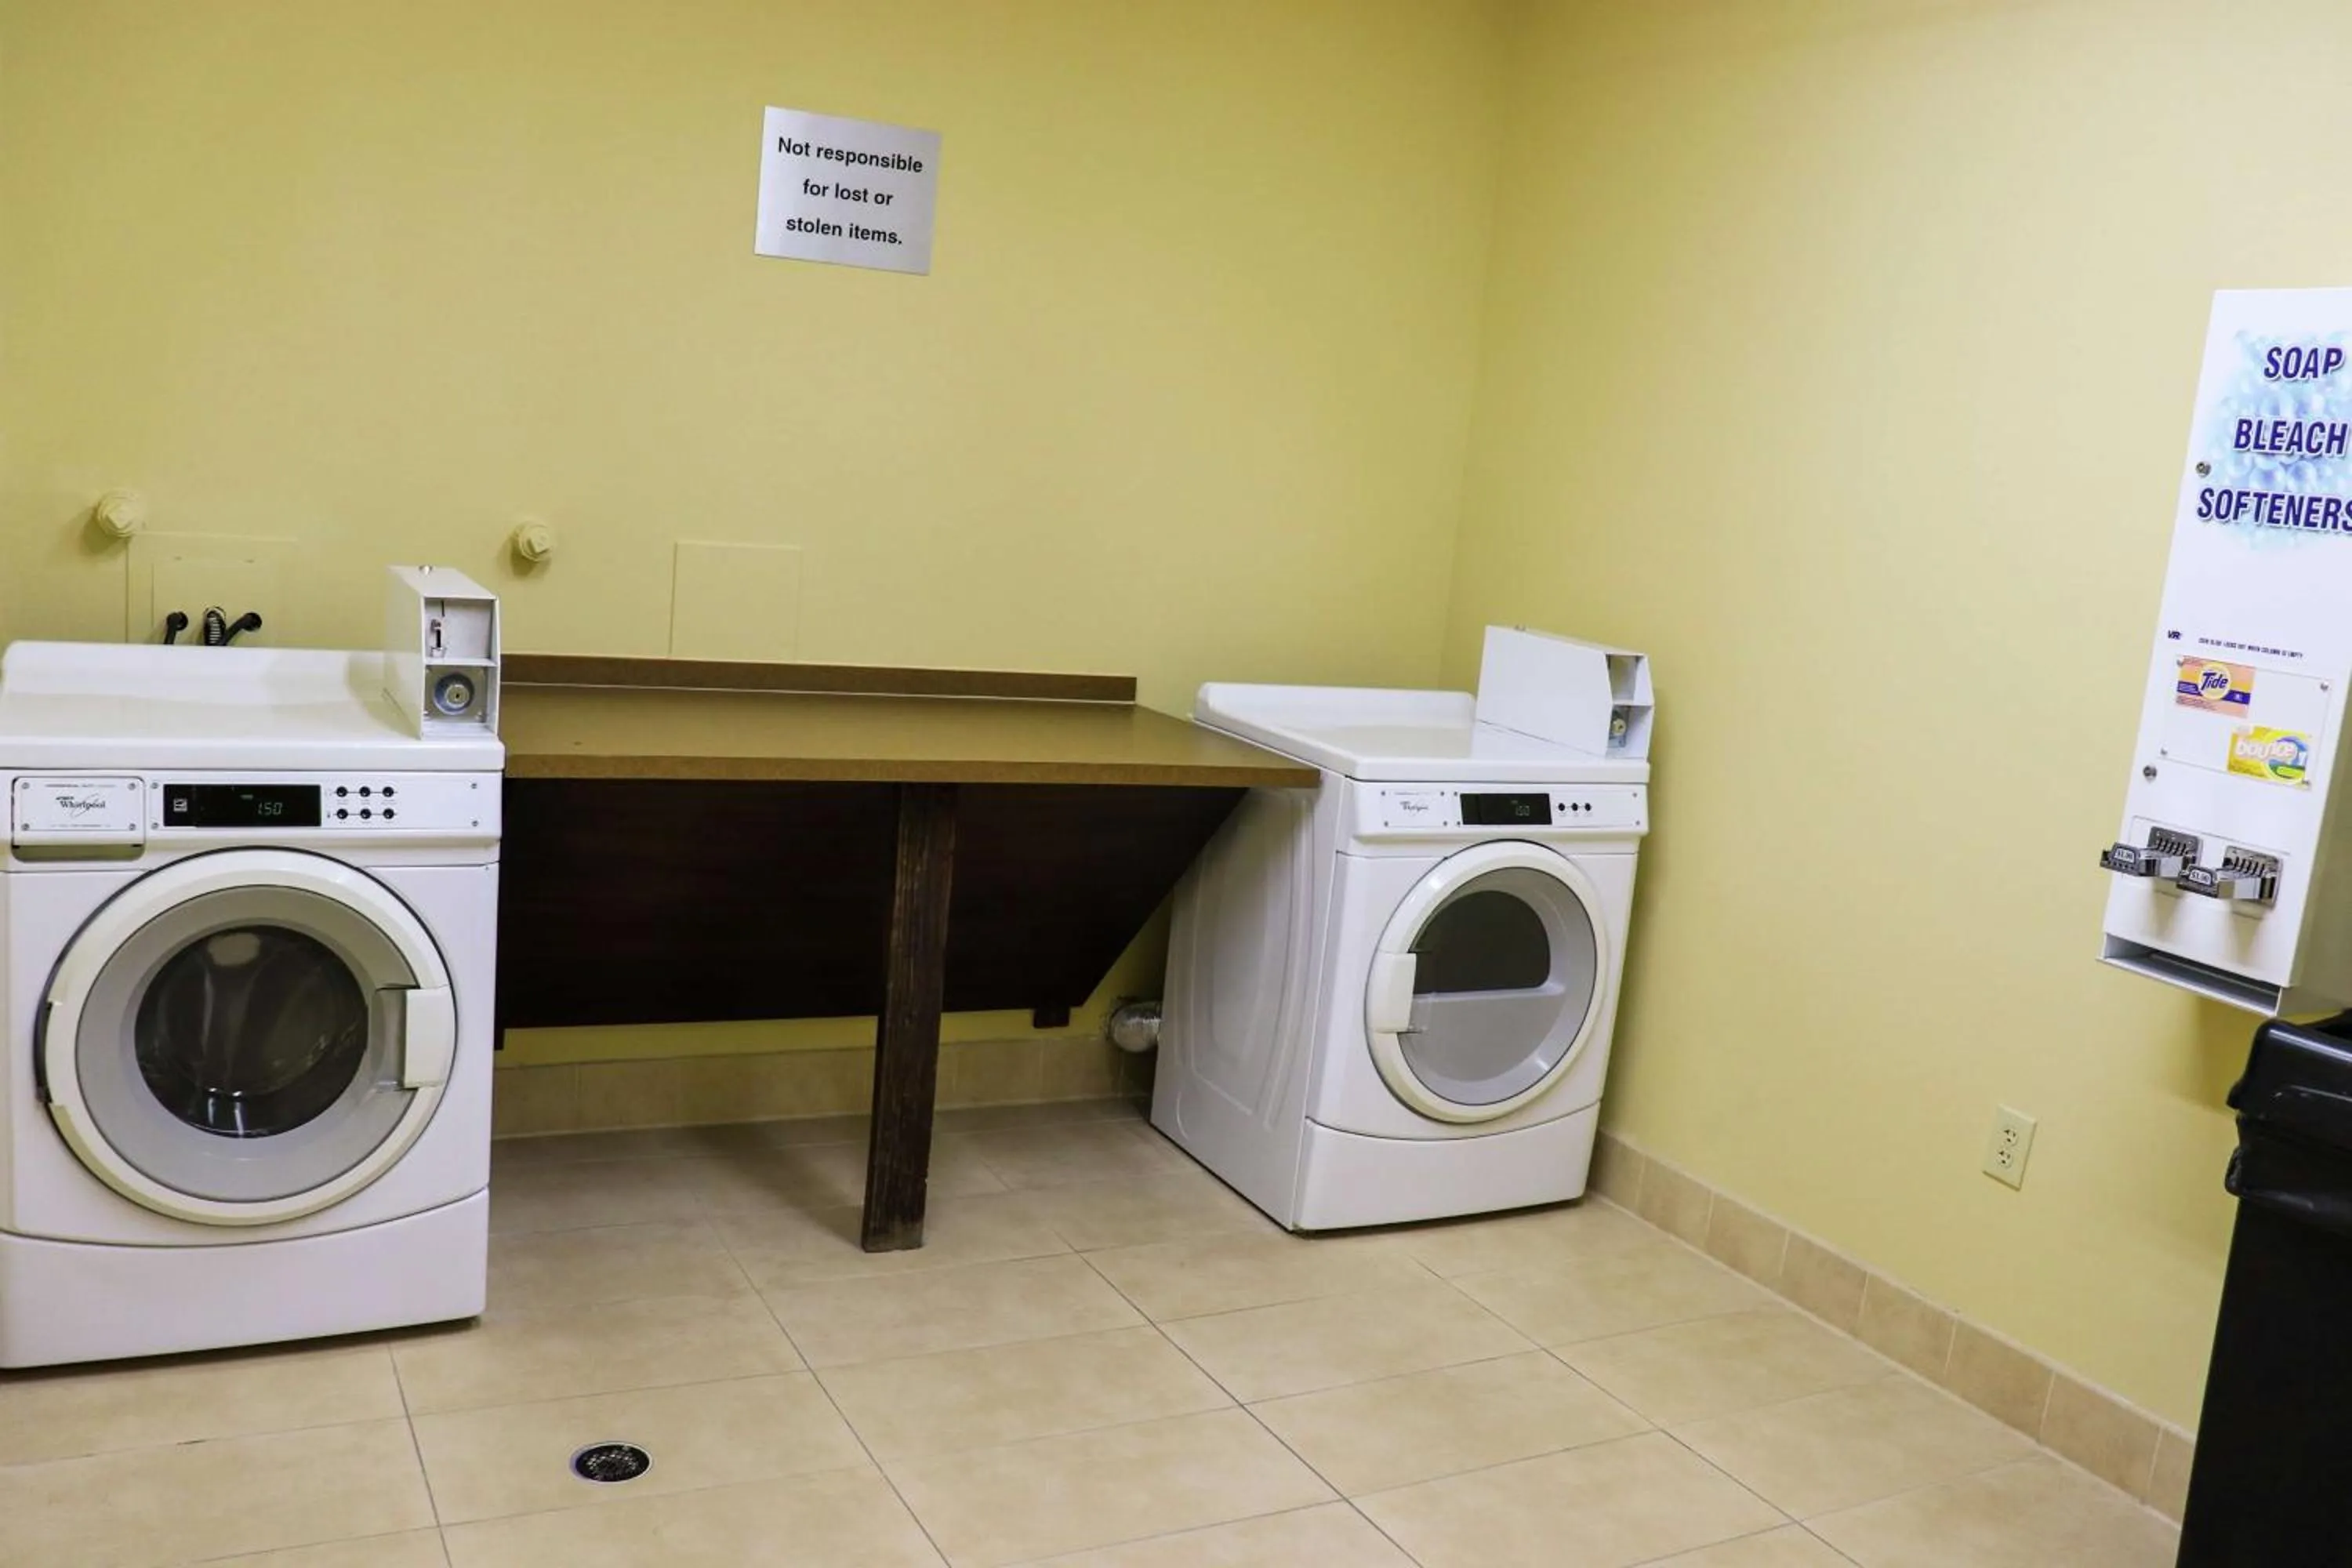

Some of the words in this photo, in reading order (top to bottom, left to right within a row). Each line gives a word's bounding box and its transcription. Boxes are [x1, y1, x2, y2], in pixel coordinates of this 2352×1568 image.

[779, 136, 811, 156] Not
[816, 146, 923, 172] responsible
[803, 178, 829, 198] for
[835, 183, 869, 203] lost
[874, 193, 894, 205] or
[786, 218, 843, 237] stolen
[849, 223, 903, 245] items.
[2263, 347, 2343, 379] SOAP
[2234, 419, 2347, 455] BLEACH
[2201, 673, 2228, 690] Tide
